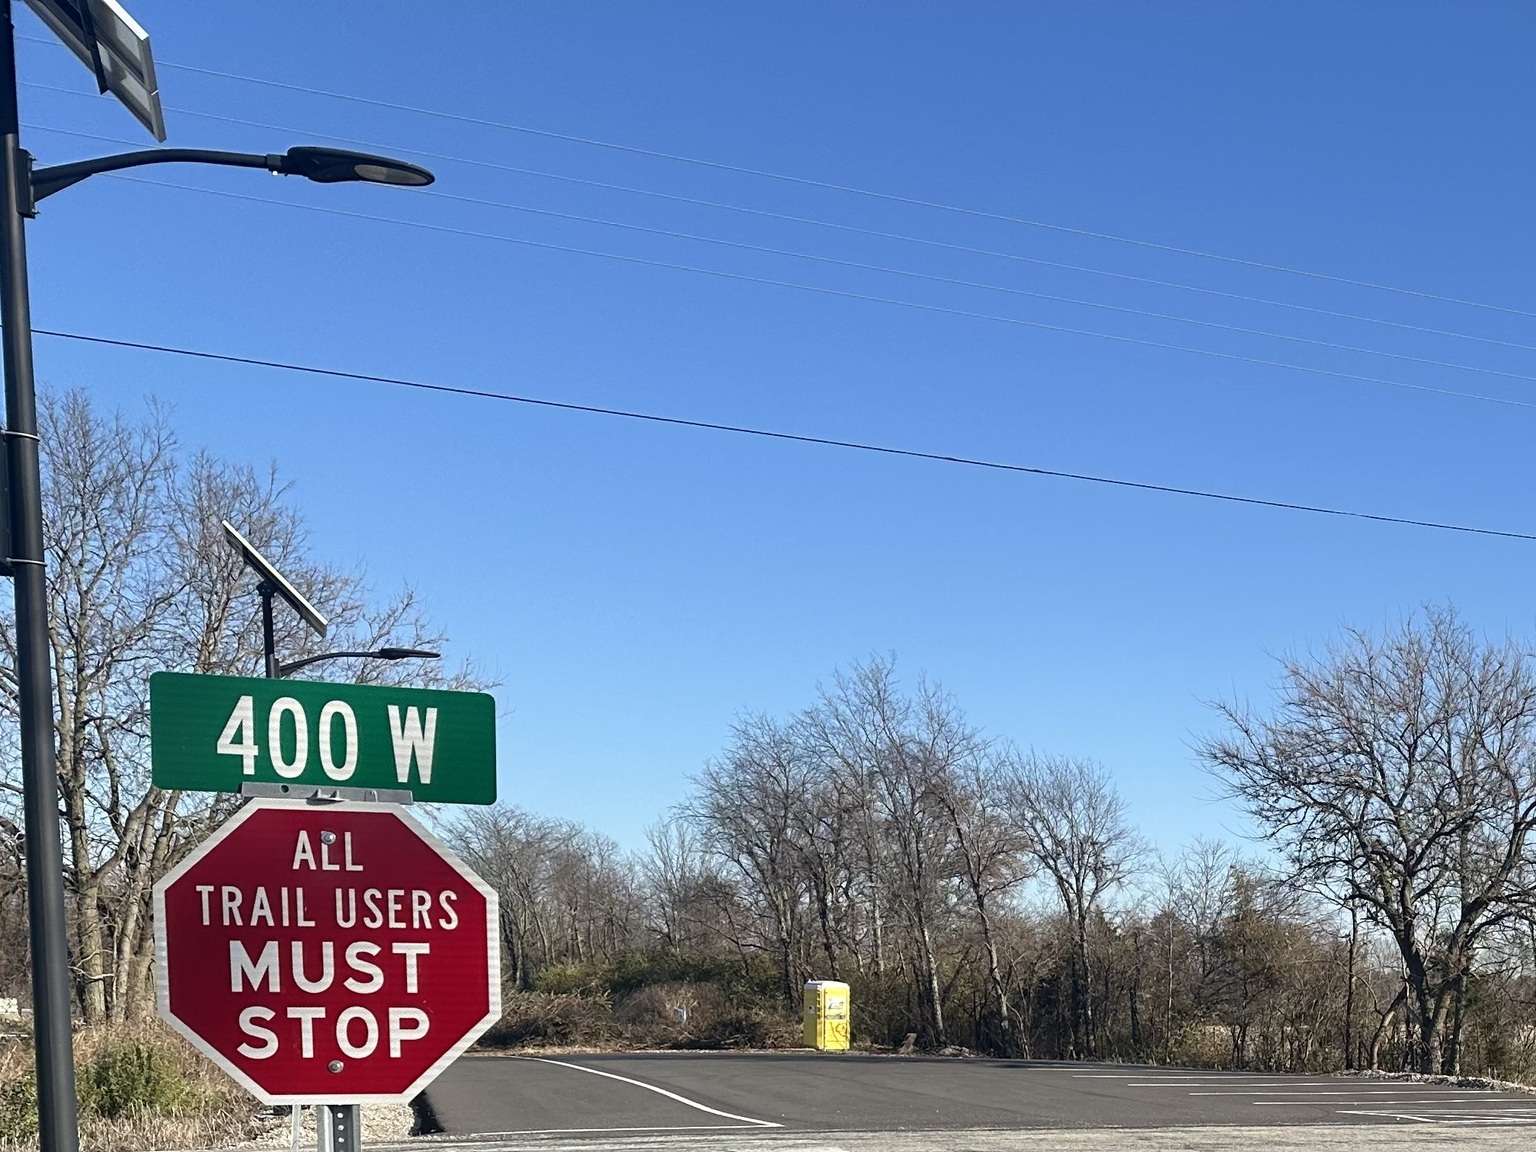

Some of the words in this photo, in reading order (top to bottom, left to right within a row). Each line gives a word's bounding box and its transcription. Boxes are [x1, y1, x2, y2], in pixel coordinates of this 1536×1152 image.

[217, 695, 359, 781] 400
[387, 704, 438, 785] W
[292, 830, 364, 871] ALL
[196, 885, 316, 928] TRAIL
[335, 887, 459, 930] USERS
[229, 940, 430, 994] MUST
[237, 1006, 431, 1060] STOP
